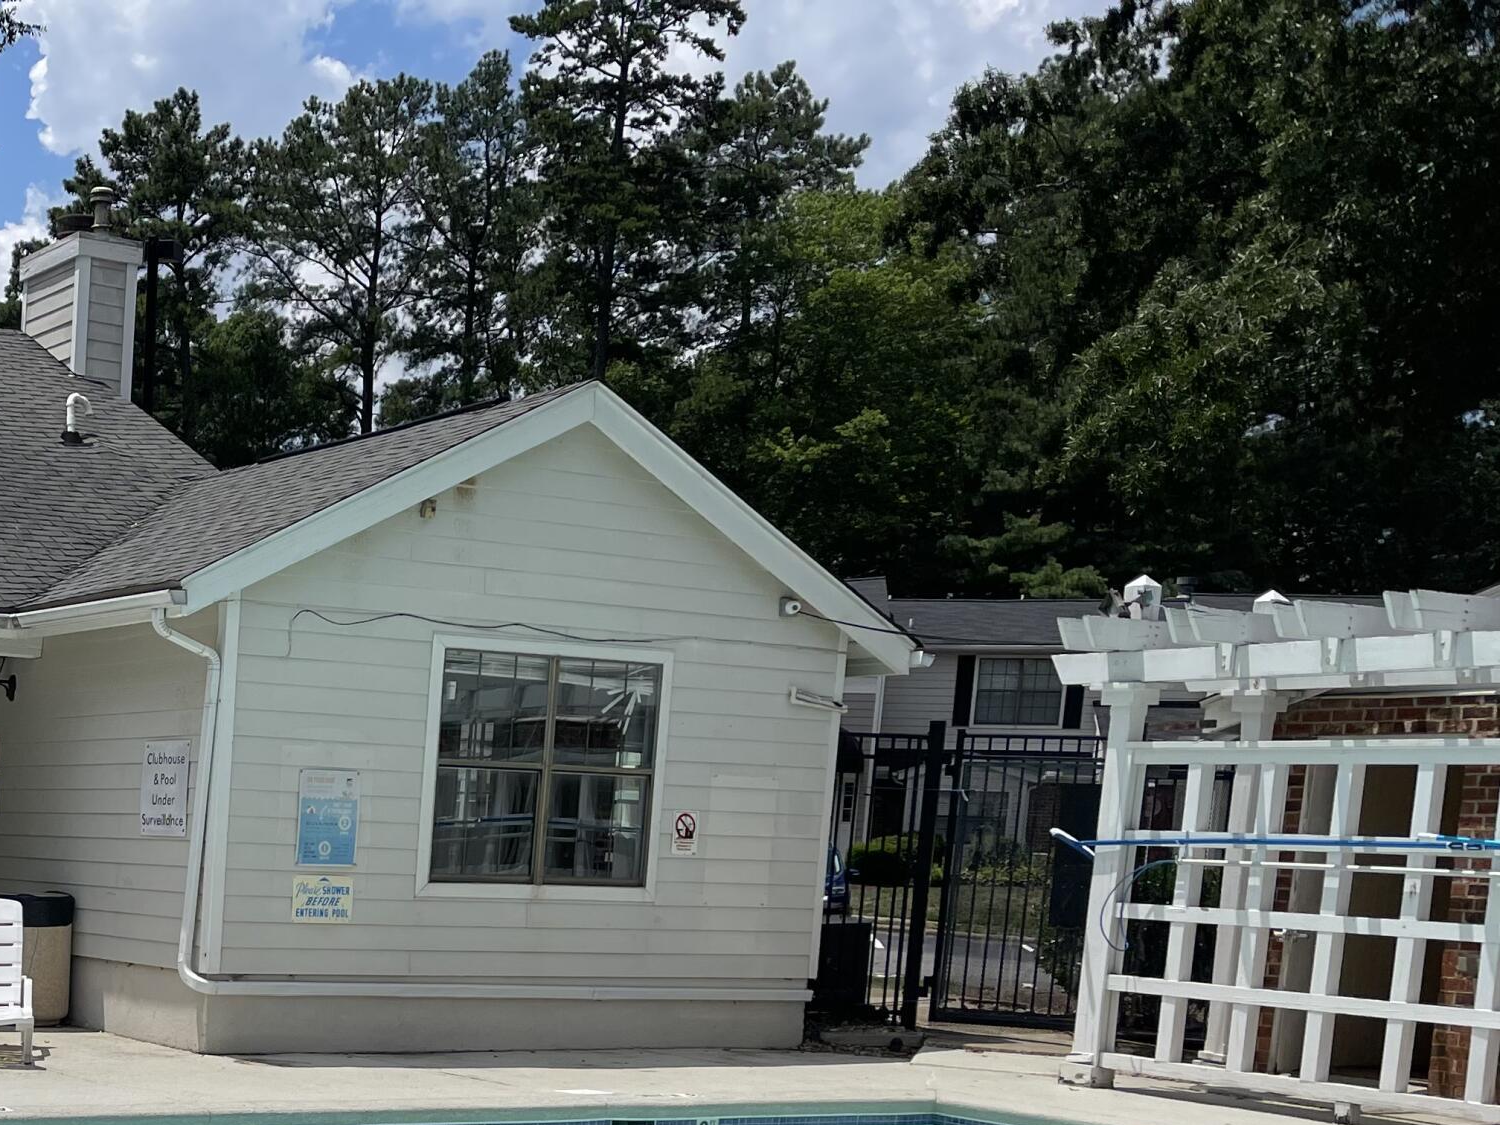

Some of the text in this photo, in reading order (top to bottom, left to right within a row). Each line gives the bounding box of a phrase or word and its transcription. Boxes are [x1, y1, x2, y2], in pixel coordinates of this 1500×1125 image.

[147, 752, 185, 765] Clubhouse
[153, 773, 176, 785] & Pool
[151, 793, 175, 805] Under
[141, 813, 184, 826] Surveillance
[322, 886, 350, 895] SHOWER
[305, 896, 342, 906] BEFORE
[295, 908, 348, 918] ENTERING POOL
